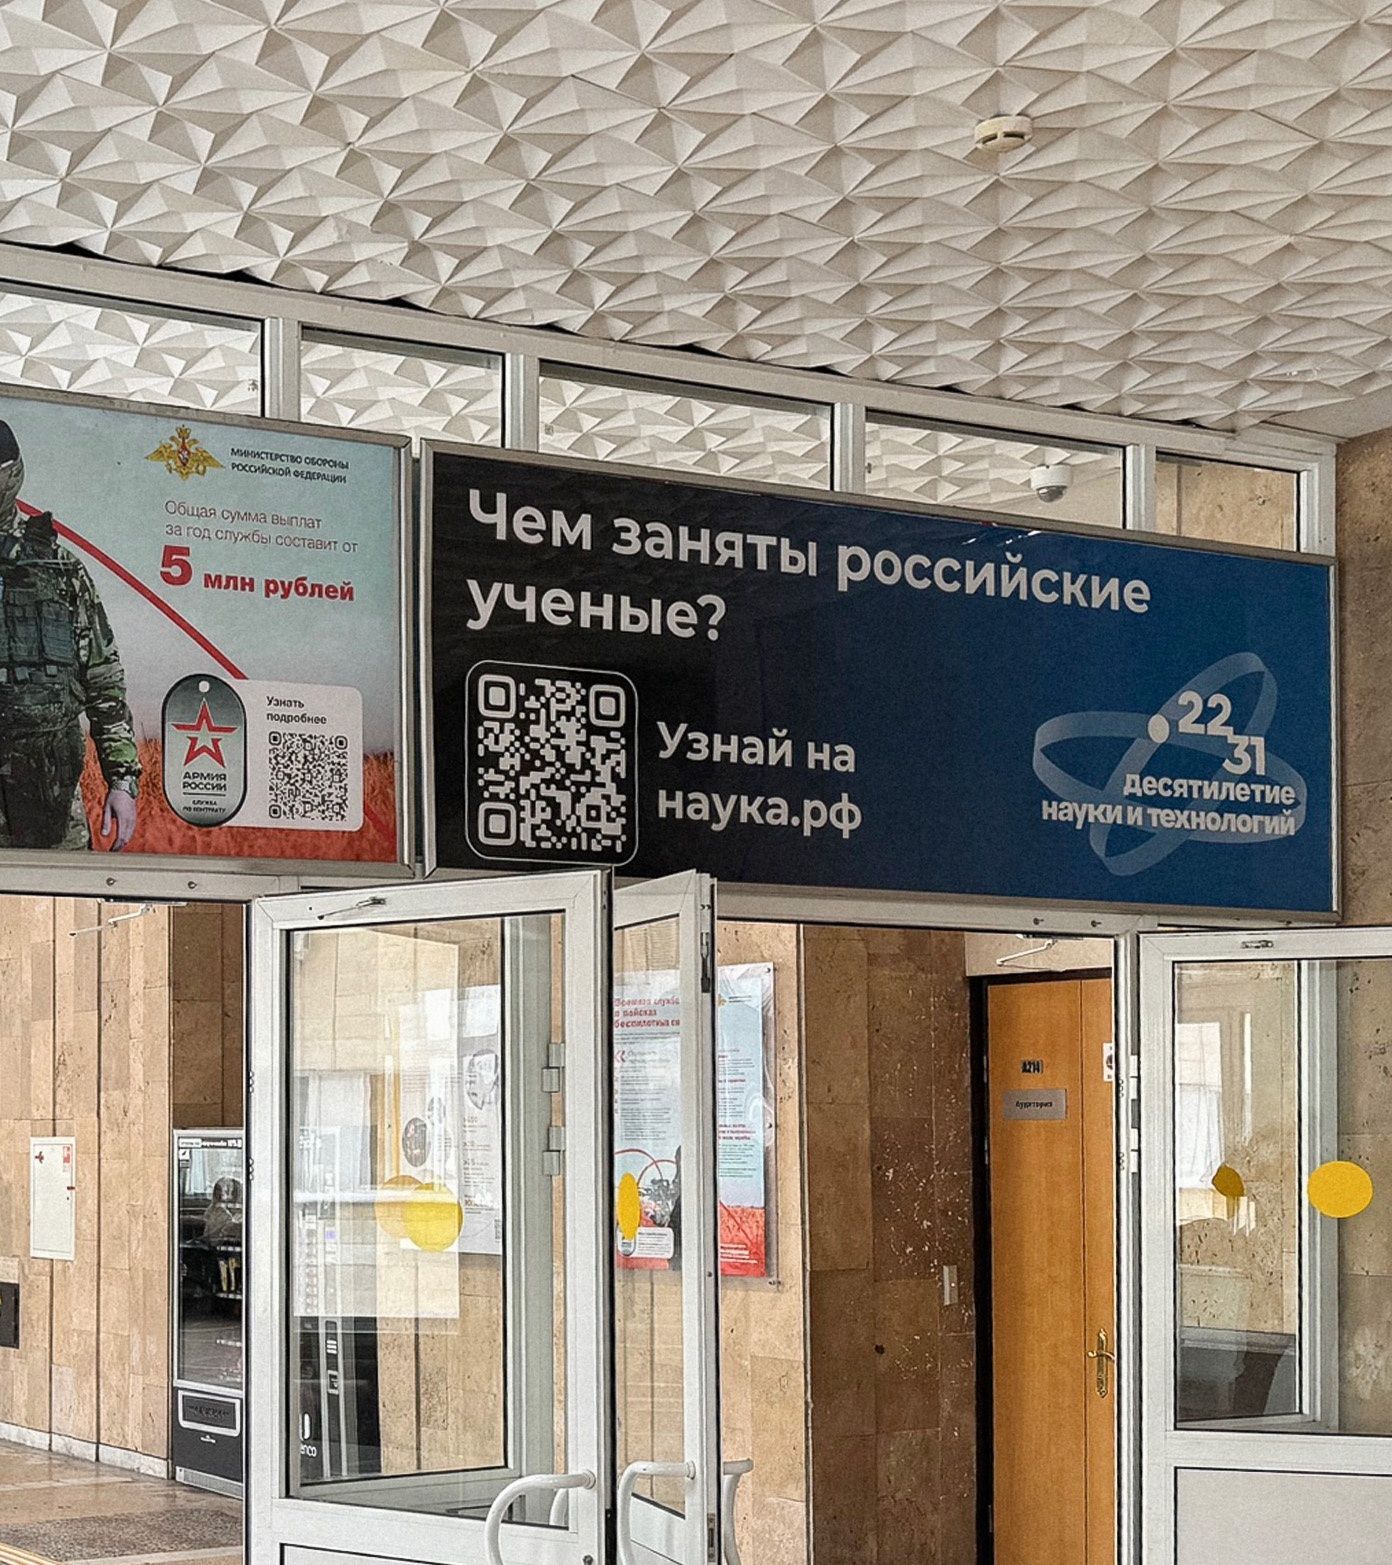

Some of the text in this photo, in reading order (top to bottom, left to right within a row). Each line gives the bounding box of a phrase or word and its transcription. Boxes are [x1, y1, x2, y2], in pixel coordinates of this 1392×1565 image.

[230, 448, 349, 470] МИНИСТЕРСТВО ОБОРОНЫ
[231, 462, 347, 484] РОССИЙСКОЙ ФЕДЕРАЦИИ
[165, 500, 322, 529] Общая сумма выплат
[165, 524, 358, 553] за год службы составит от
[468, 488, 1151, 614] Чем заняты российские
[160, 545, 355, 601] 5 млн рублей
[466, 577, 725, 641] ученые?
[266, 696, 305, 709] Узнать
[266, 712, 327, 725] подробнее
[1177, 690, 1234, 736] 22
[656, 720, 855, 772] Узнай на
[1222, 734, 1266, 775] 31
[182, 781, 227, 791] РОССИИ
[183, 771, 227, 781] АРМИЯ
[657, 788, 863, 839] наука.рф
[1042, 800, 1295, 835] науки и технологий
